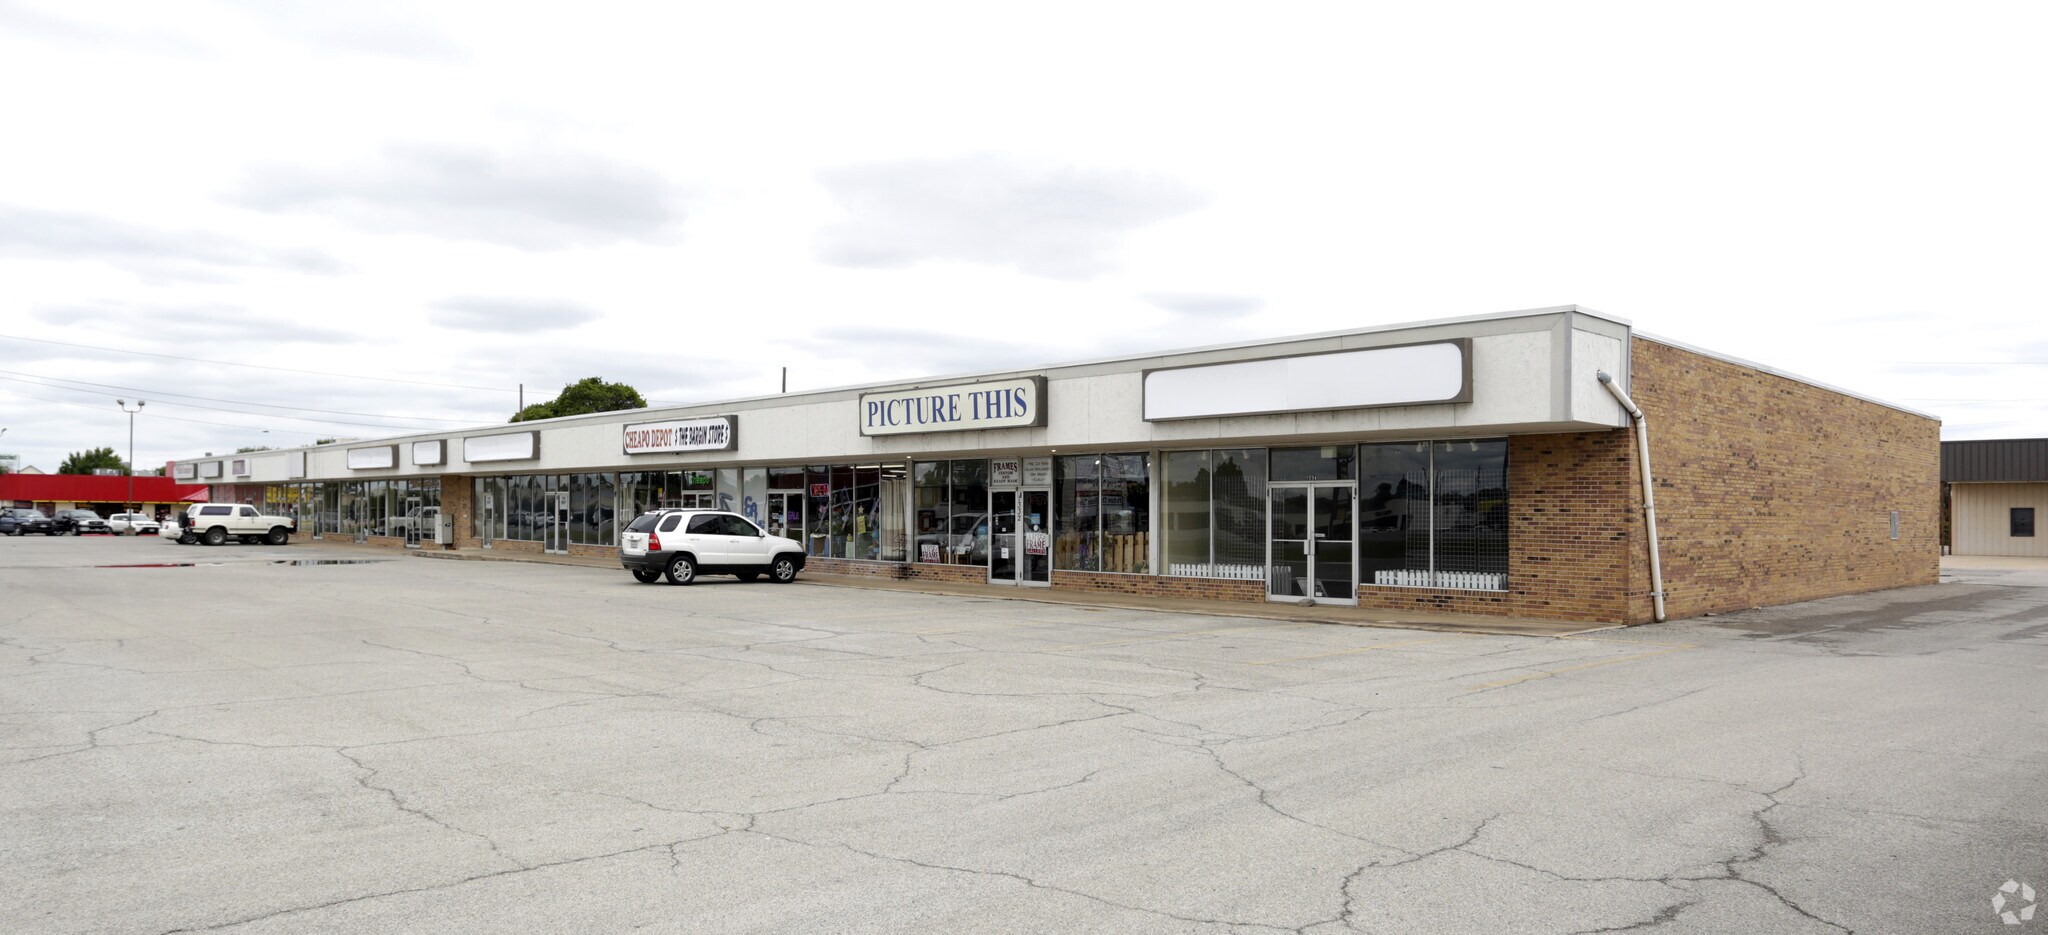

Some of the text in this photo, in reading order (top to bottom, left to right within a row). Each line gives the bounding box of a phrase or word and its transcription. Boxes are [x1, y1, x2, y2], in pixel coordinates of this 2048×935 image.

[867, 387, 1027, 427] PICTURE THIS
[625, 430, 650, 448] CHEAPO
[651, 428, 673, 447] DEPOT
[679, 427, 689, 445] THE
[689, 425, 707, 446] BARGIN
[707, 424, 725, 444] STORE
[993, 462, 1018, 473] FRAMES
[1027, 540, 1046, 549] FRAME
[922, 551, 939, 559] FRAME
